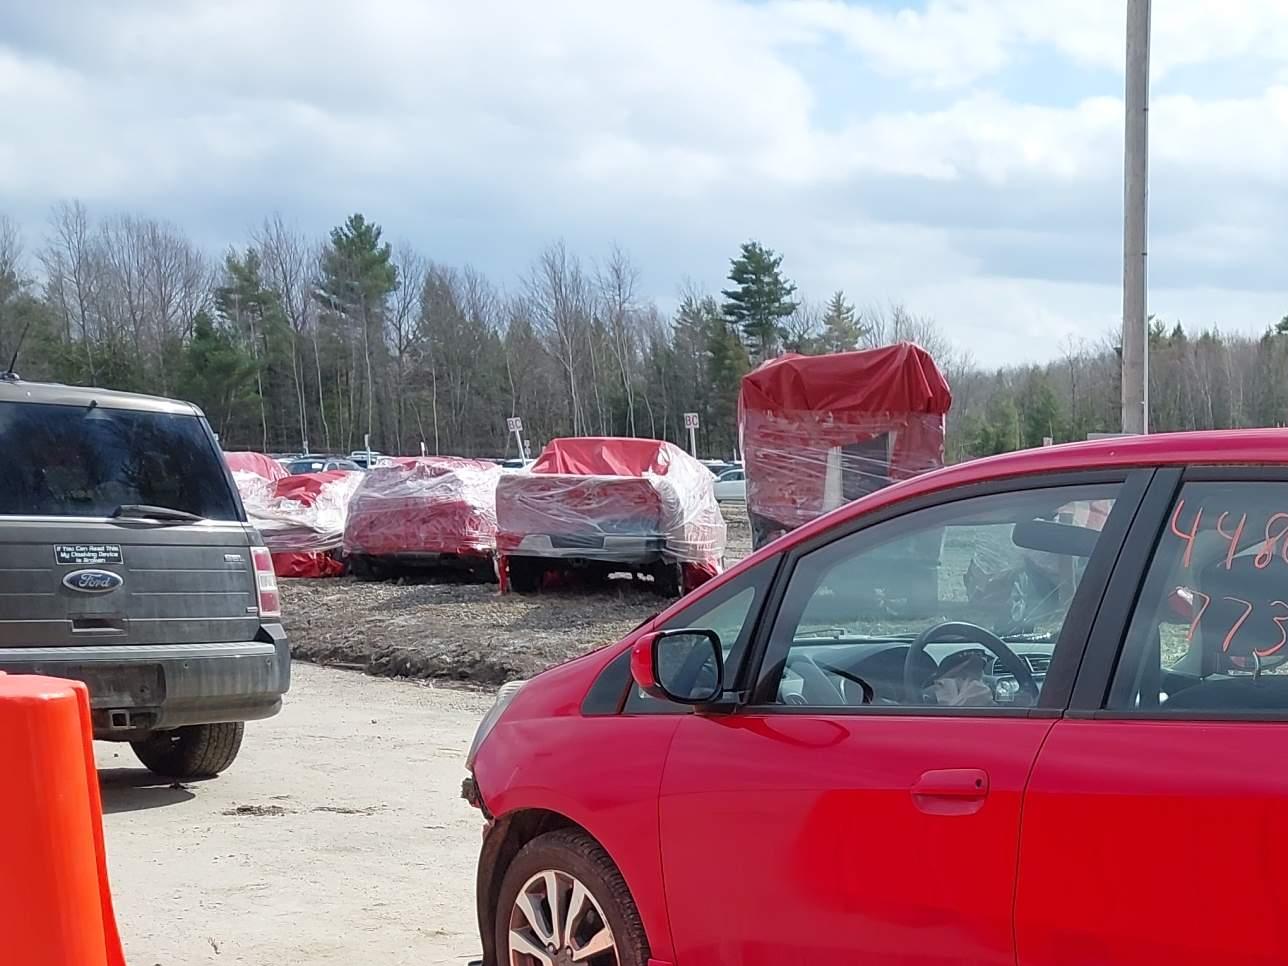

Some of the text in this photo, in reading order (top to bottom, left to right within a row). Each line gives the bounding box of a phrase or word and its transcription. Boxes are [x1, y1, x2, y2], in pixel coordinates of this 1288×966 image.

[508, 419, 521, 430] BC
[685, 415, 698, 426] BC
[78, 573, 111, 587] Ford
